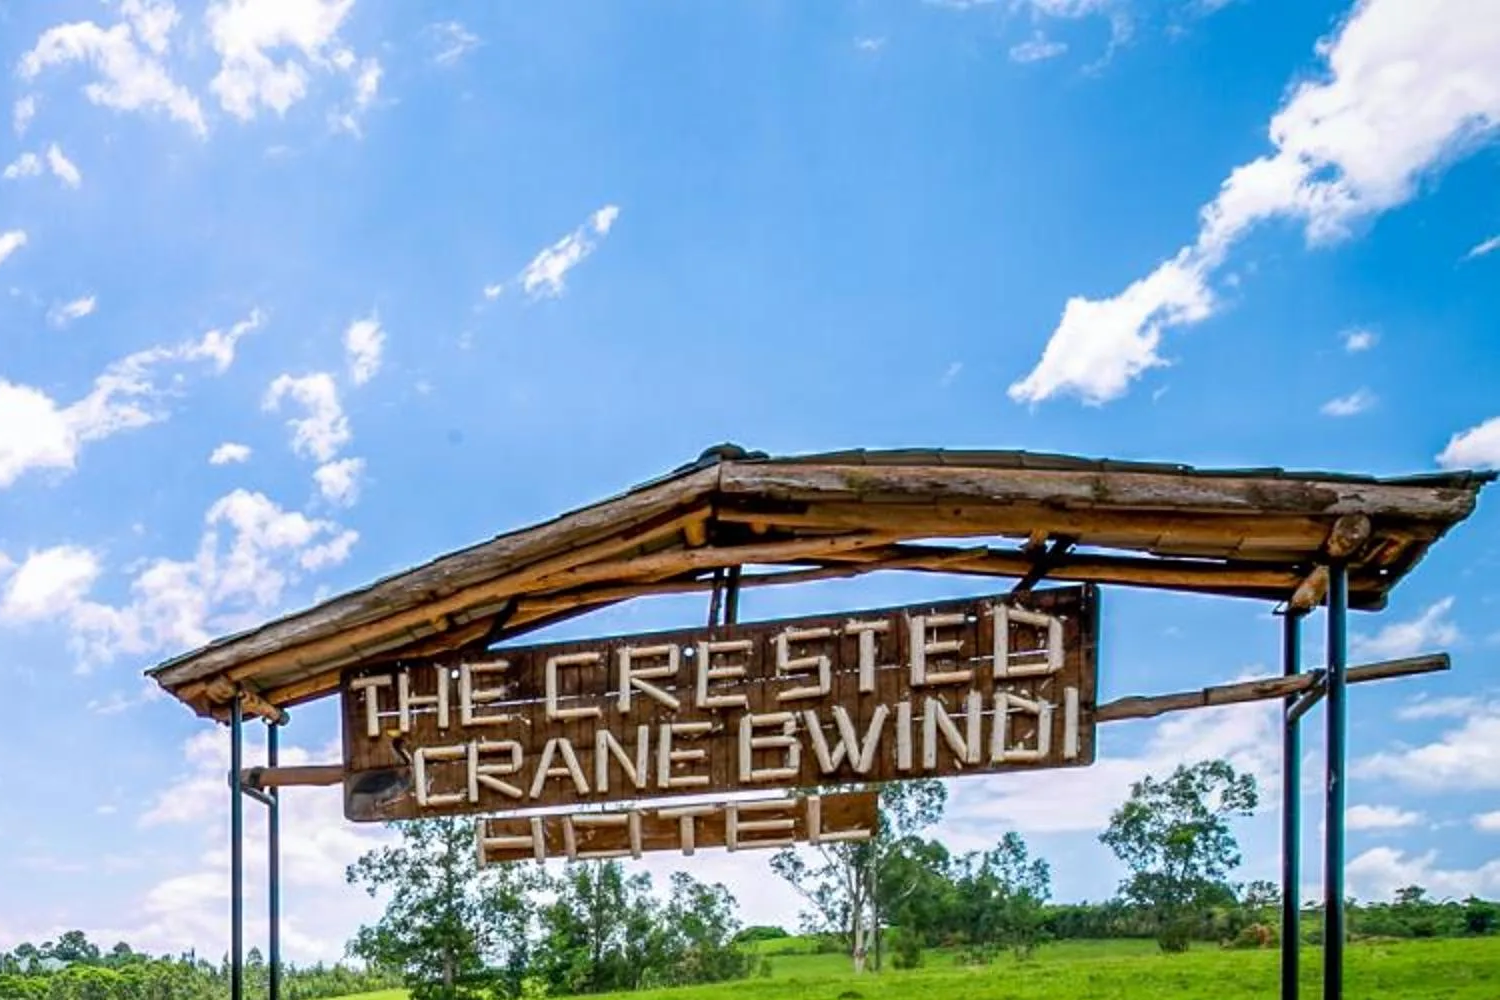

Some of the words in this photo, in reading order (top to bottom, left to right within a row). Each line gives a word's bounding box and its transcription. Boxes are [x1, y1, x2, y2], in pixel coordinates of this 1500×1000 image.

[352, 661, 510, 736] THE
[546, 605, 1064, 723] CRESTED
[414, 722, 712, 806] CRANE
[739, 687, 1078, 782] BWINDI
[477, 795, 871, 867] HOTEL
